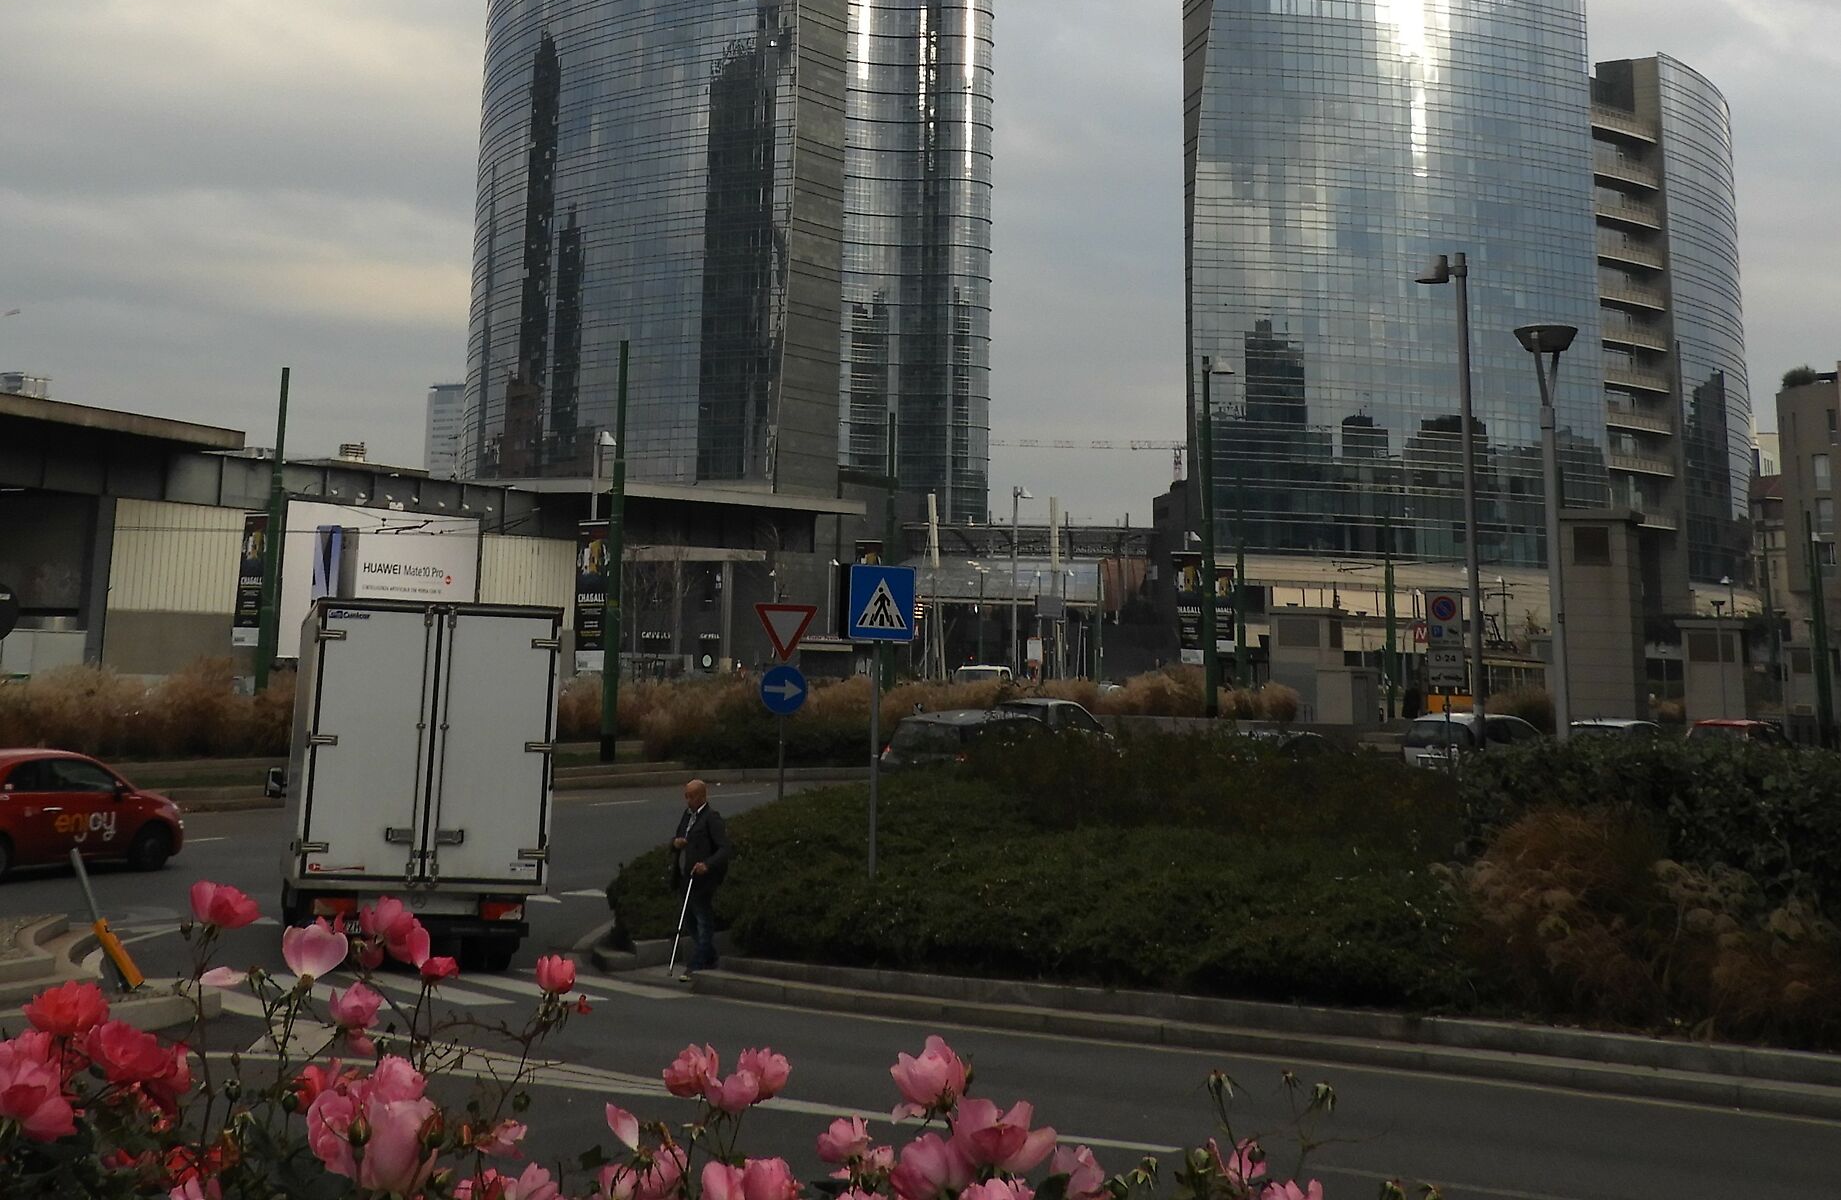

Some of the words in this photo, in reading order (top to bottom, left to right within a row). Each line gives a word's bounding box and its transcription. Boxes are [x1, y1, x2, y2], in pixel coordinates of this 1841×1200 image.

[363, 562, 401, 575] HUAWEI
[403, 565, 430, 577] Mate10
[431, 567, 444, 579] Pro
[577, 593, 604, 603] CHAGALL
[54, 812, 116, 842] enjoy
